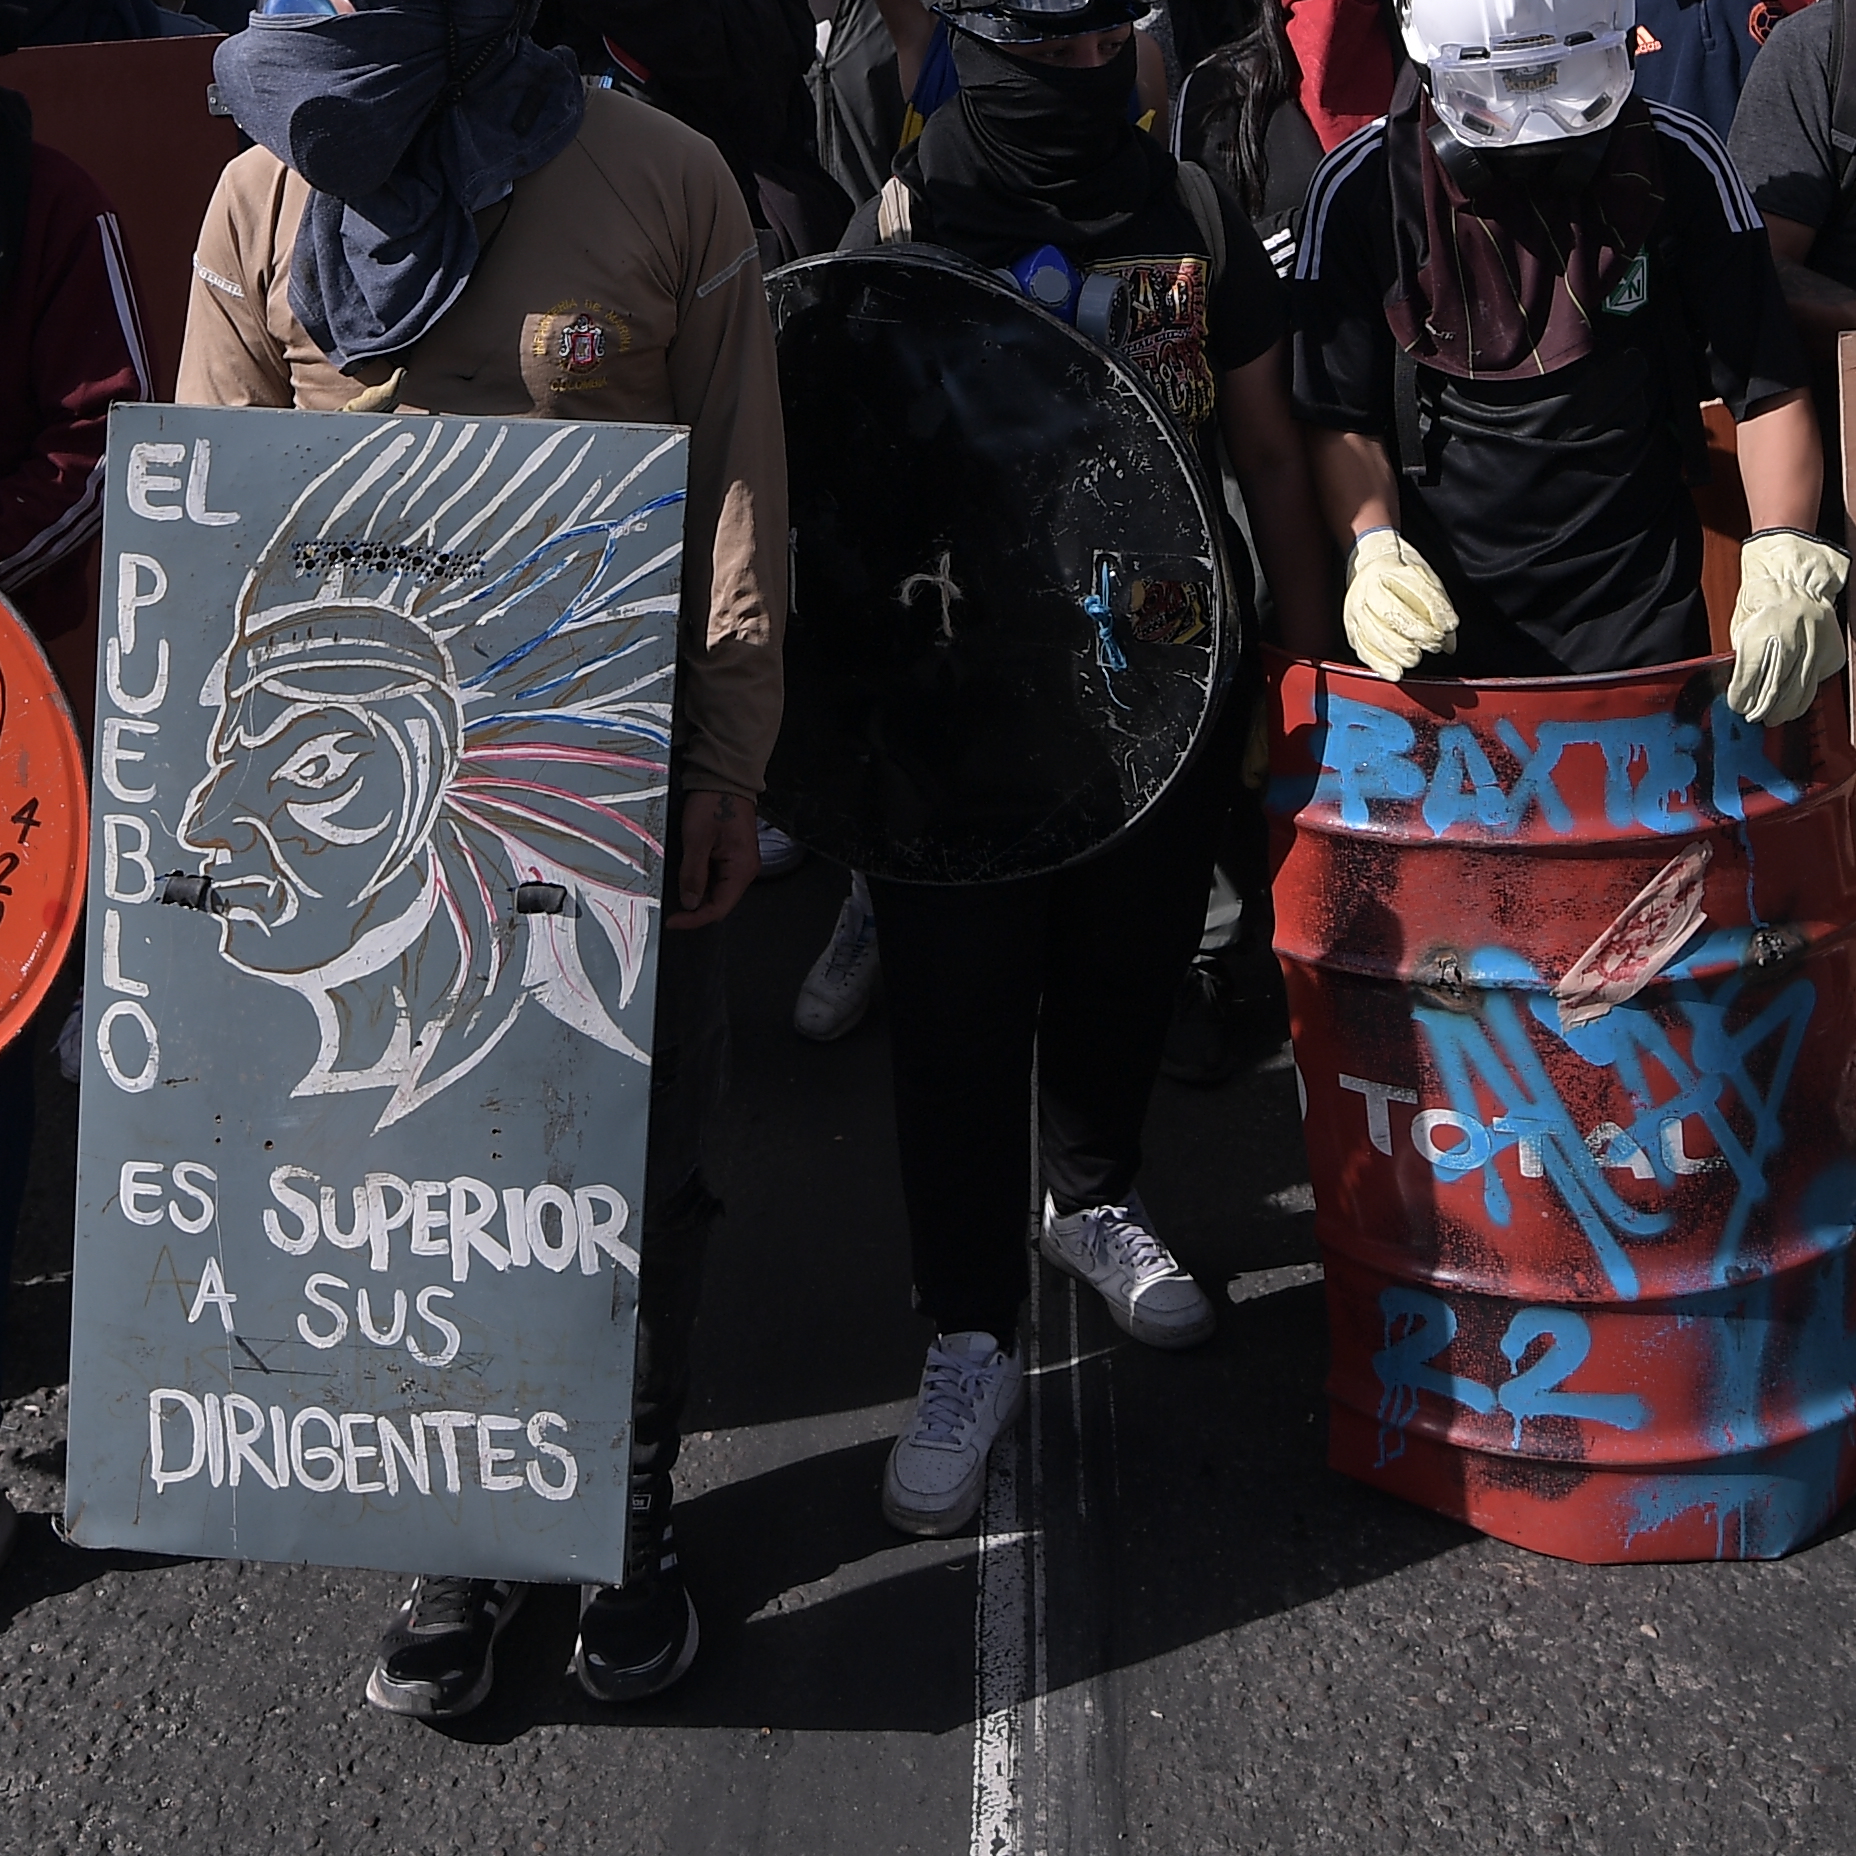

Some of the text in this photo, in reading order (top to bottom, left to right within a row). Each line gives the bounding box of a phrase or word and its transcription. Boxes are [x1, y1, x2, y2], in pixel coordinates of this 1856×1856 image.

[584, 298, 603, 313] DE
[126, 438, 241, 526] EL
[1314, 689, 1803, 837] BAXTER
[96, 552, 169, 1092] PUEBLO
[1338, 1072, 1730, 1181] TOTAL
[119, 1160, 640, 1282] ES SUPERIOR
[187, 1256, 461, 1367] A SUS
[149, 1387, 578, 1501] DIRIGENTES
